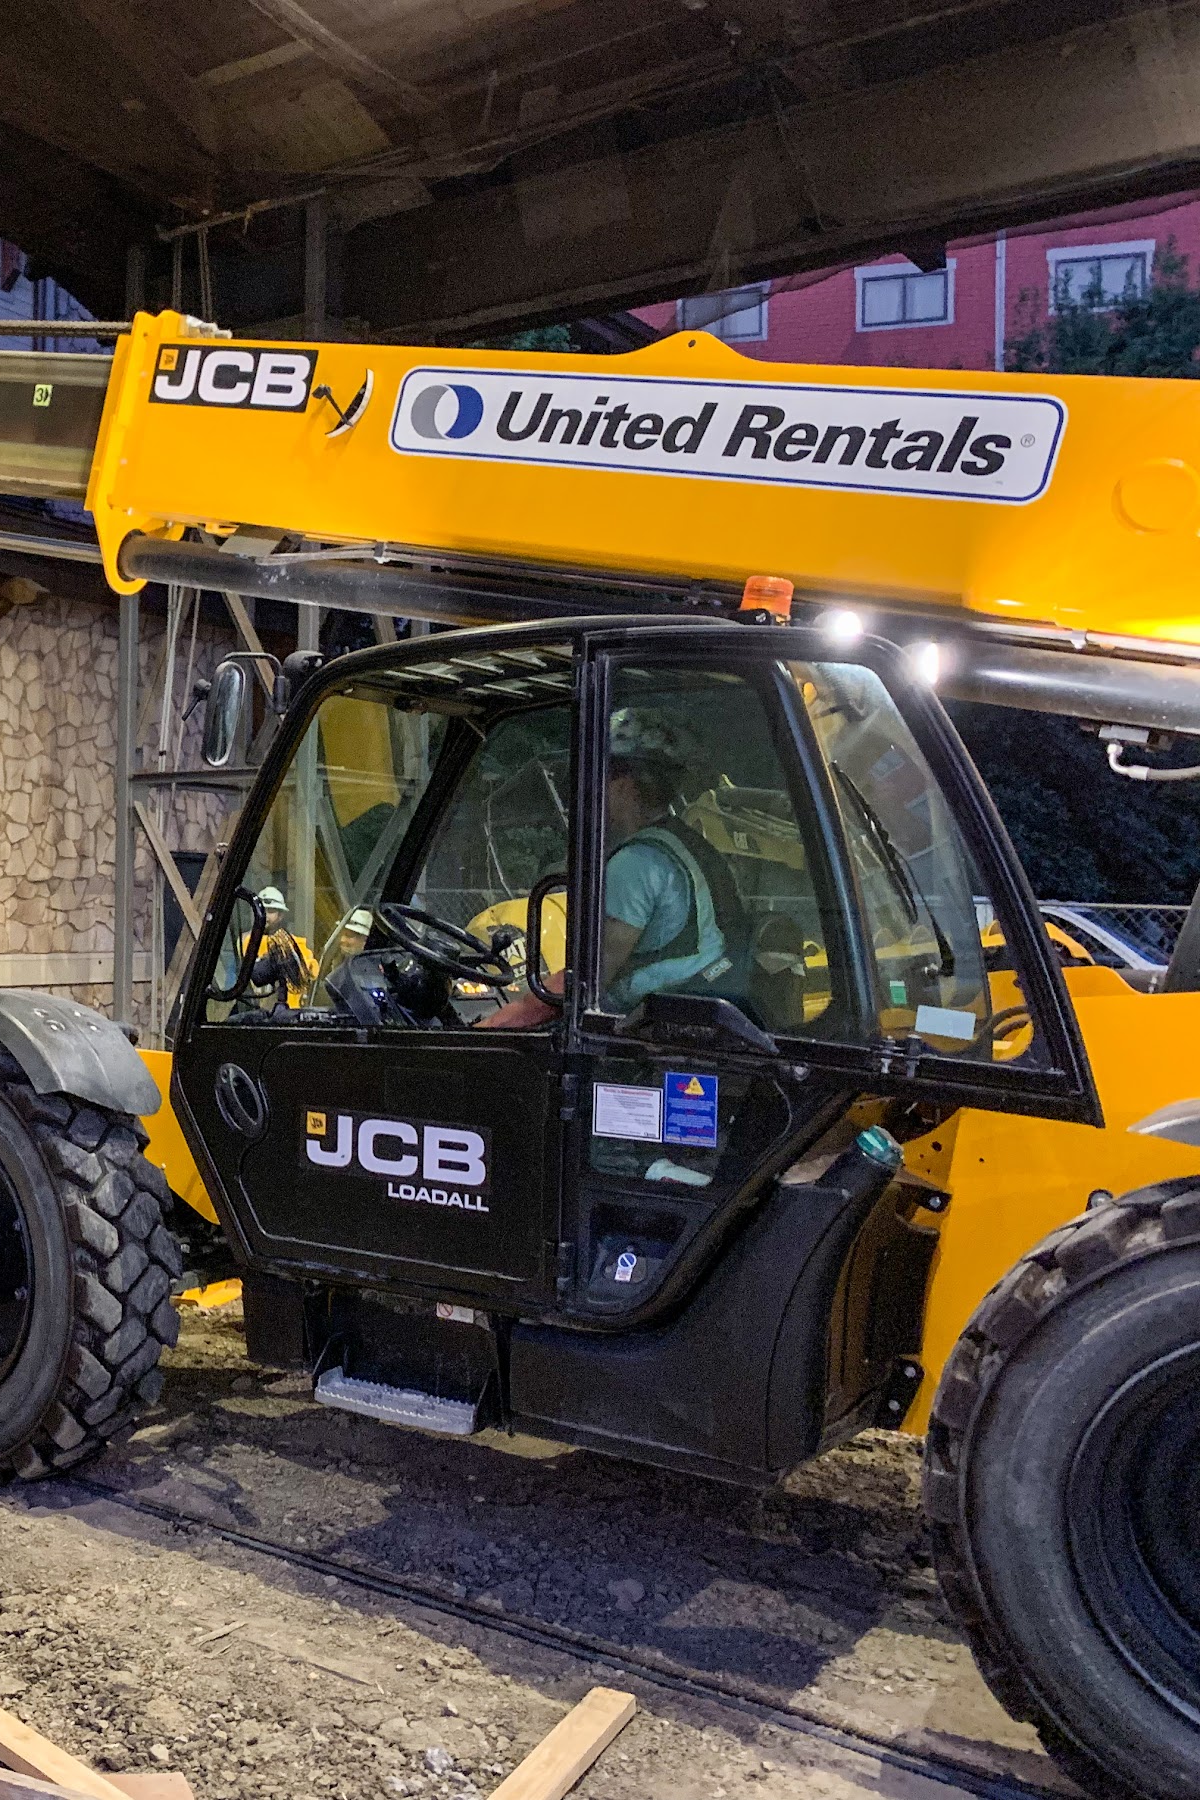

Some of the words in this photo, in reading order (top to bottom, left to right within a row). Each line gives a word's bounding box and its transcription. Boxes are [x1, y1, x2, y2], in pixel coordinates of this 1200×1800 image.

[154, 349, 311, 407] JCB
[496, 391, 718, 454] United
[722, 404, 1012, 476] Rentals
[306, 1115, 486, 1186] JCB
[387, 1182, 490, 1213] LOADALL
